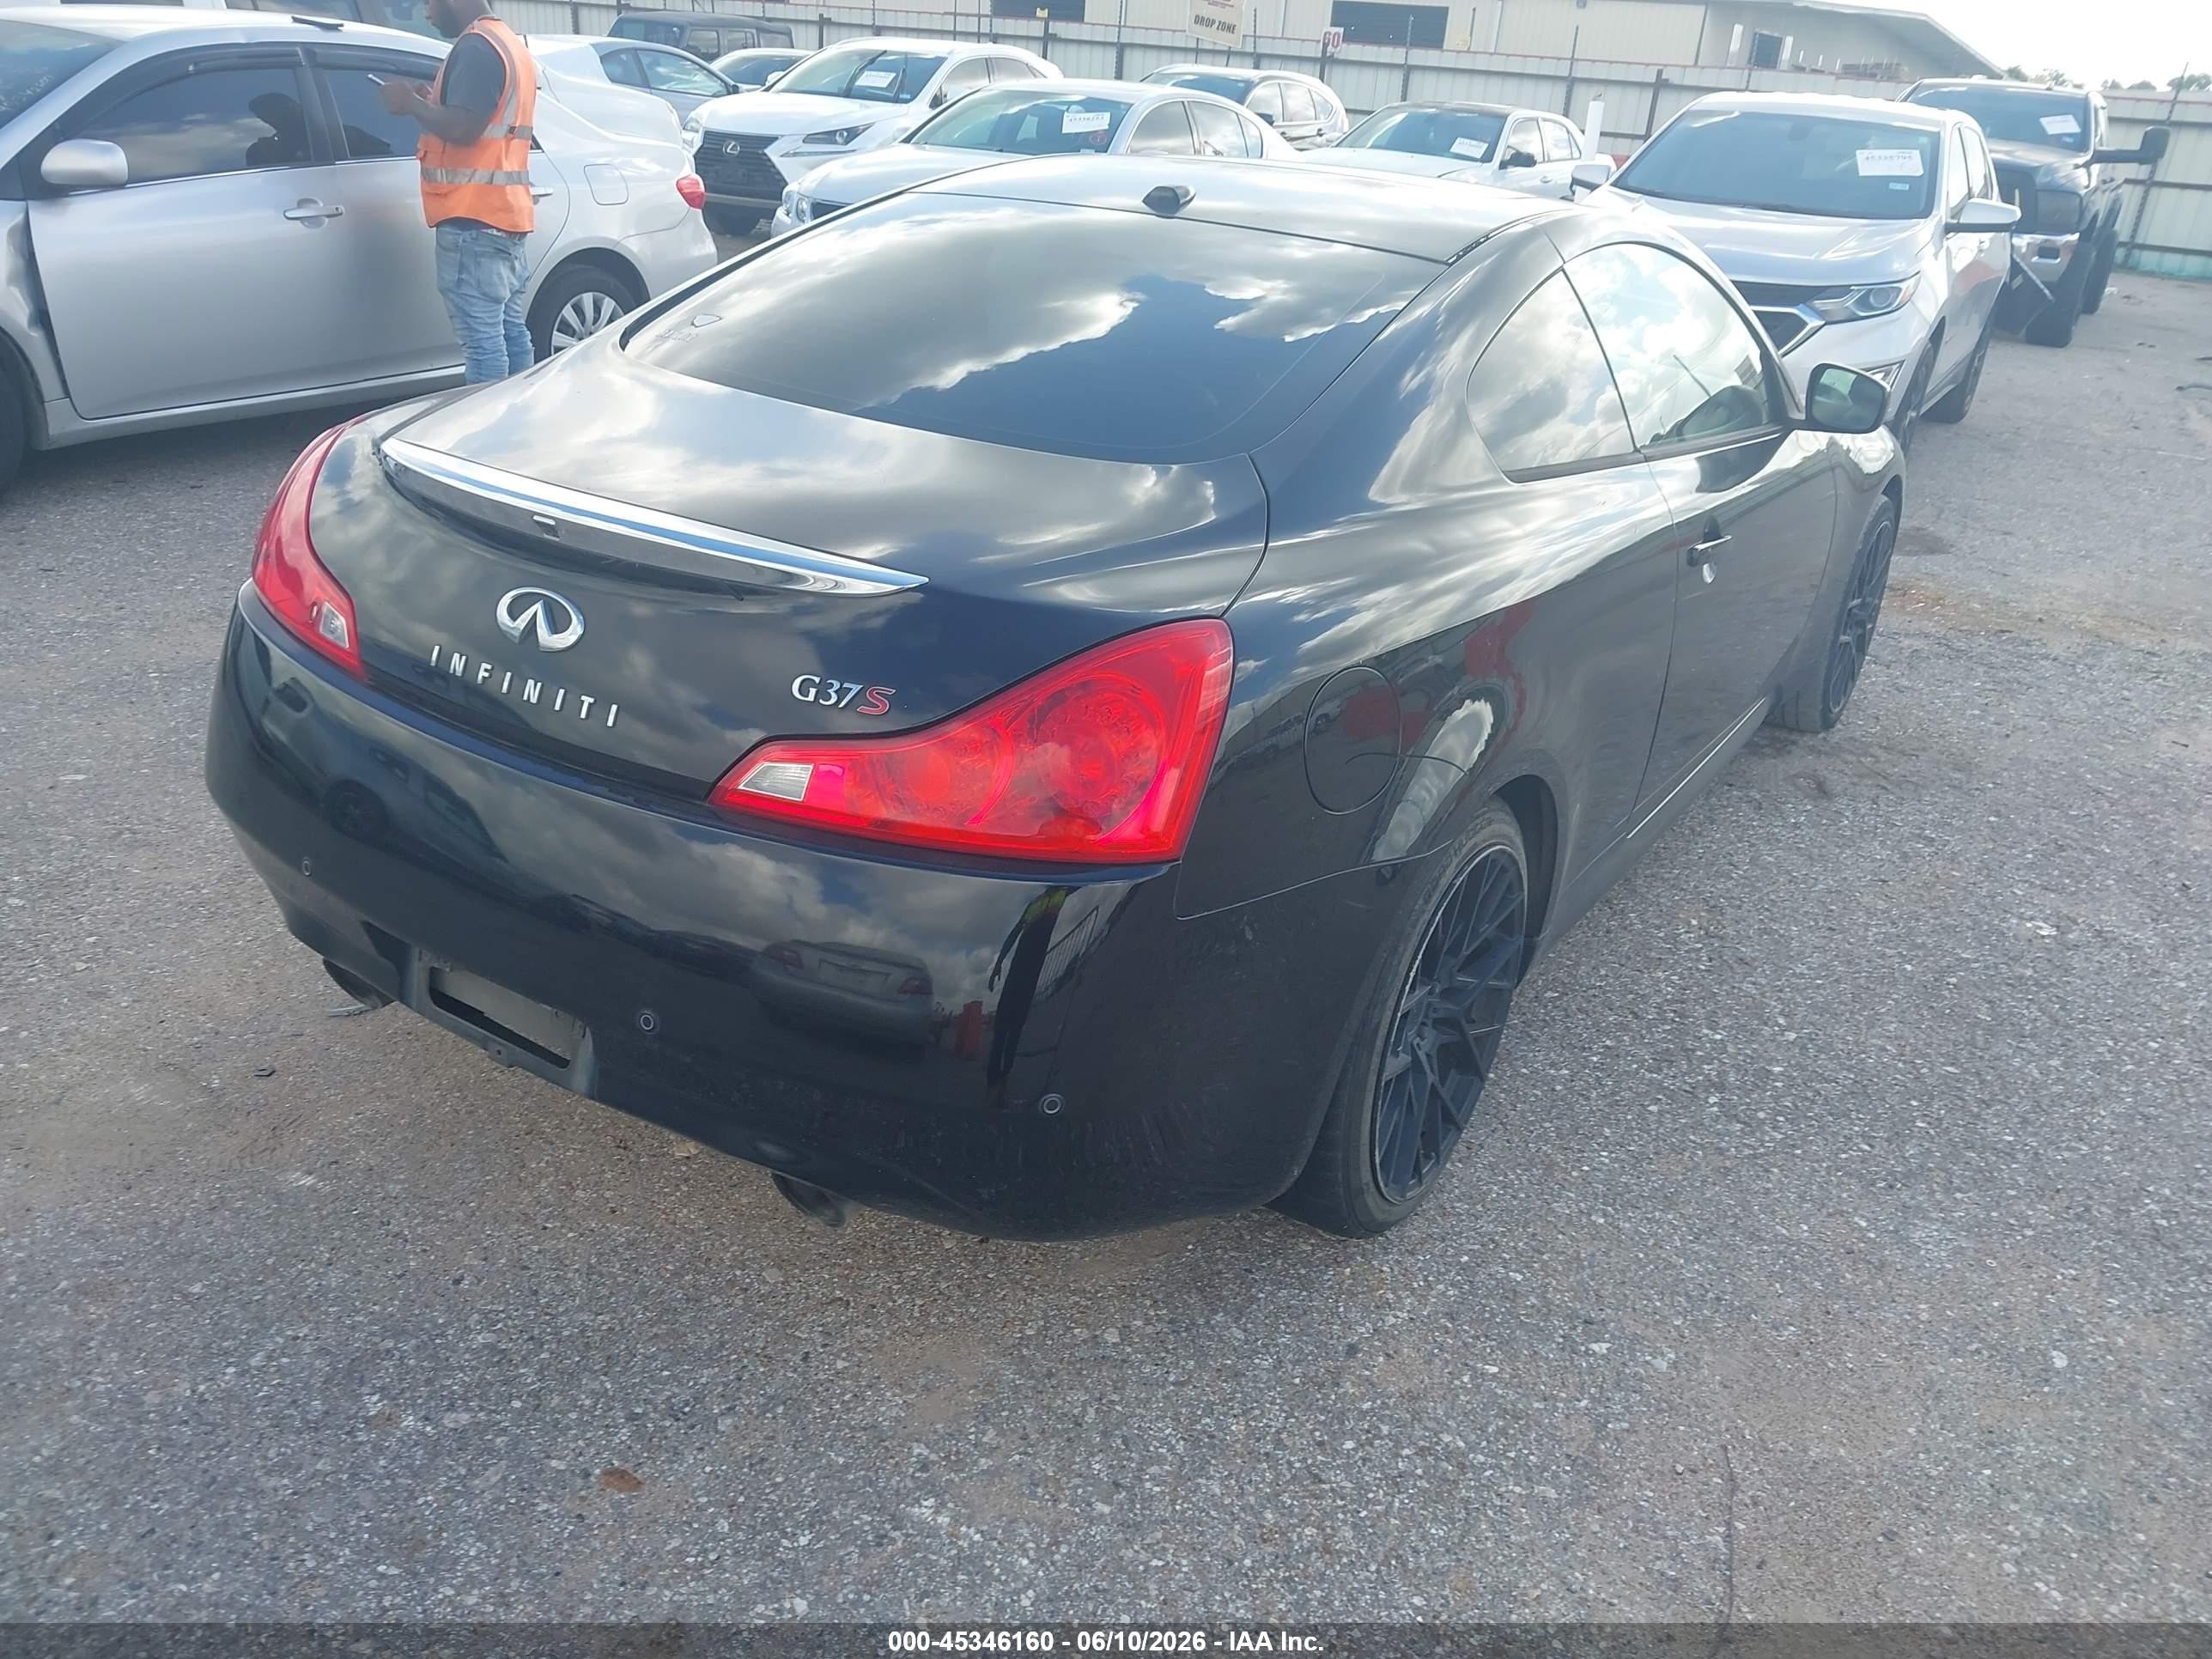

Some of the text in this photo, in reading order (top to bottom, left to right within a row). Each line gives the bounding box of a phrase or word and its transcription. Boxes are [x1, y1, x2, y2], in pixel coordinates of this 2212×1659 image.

[1194, 14, 1237, 34] DROP ZONE
[429, 644, 619, 728] INFINITI
